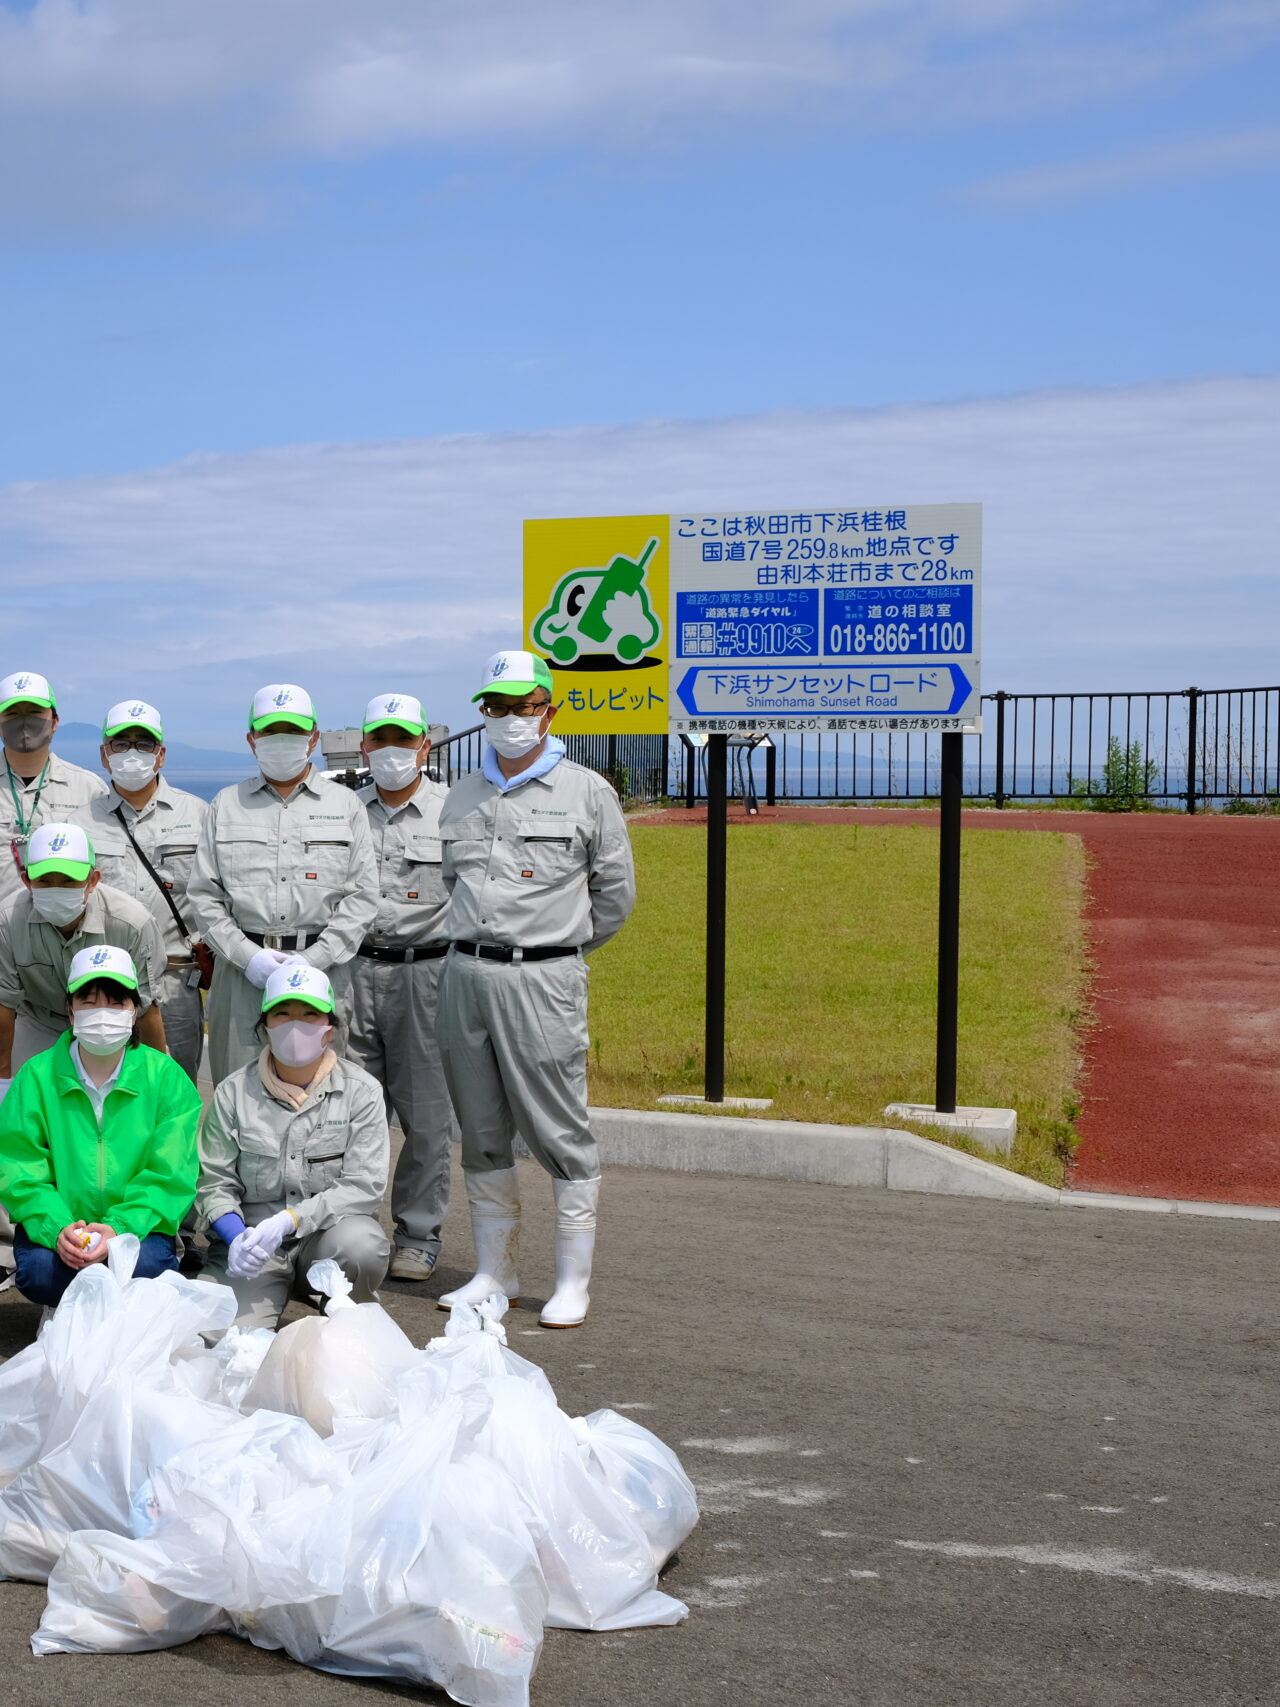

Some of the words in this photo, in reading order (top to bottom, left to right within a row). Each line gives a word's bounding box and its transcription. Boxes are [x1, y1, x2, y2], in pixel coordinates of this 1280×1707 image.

[678, 510, 907, 537] ここは秋田市下浜桂根
[757, 559, 974, 585] 由利本荘市まで28km
[686, 592, 809, 605] 道路の異常を発見したら
[833, 587, 960, 601] 道路についてのご相談は
[868, 604, 952, 619] 道の相談室
[830, 622, 966, 653] 018-866-1100
[707, 673, 938, 695] 下浜サンセットロード
[746, 695, 815, 708] Shimohama
[820, 695, 861, 707] Sunset
[865, 695, 898, 707] Road
